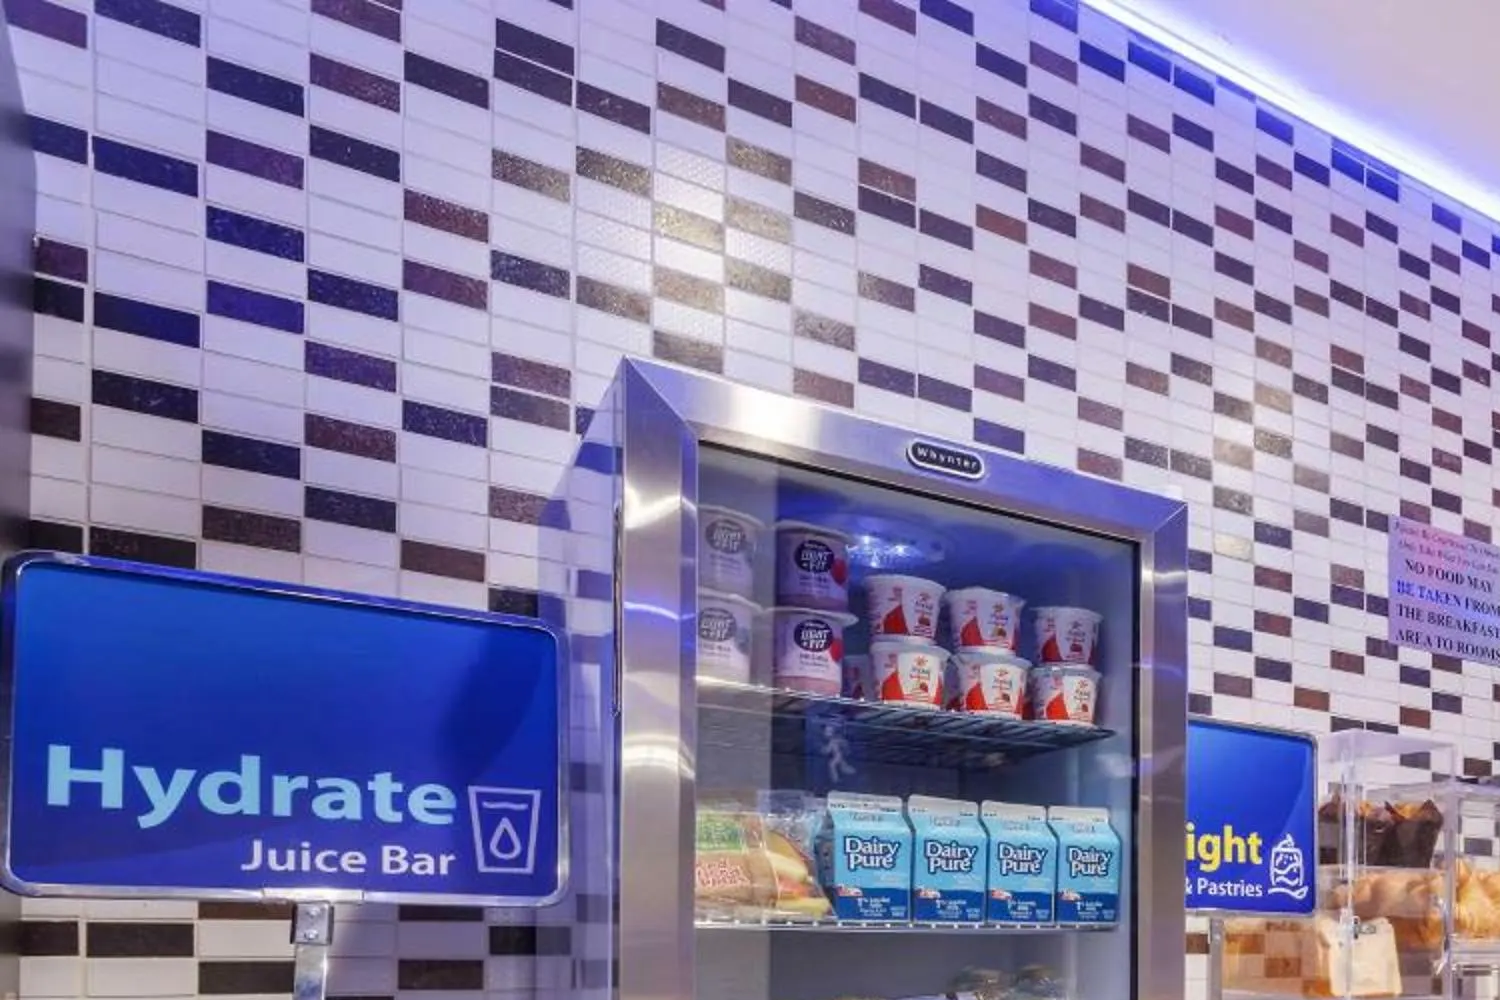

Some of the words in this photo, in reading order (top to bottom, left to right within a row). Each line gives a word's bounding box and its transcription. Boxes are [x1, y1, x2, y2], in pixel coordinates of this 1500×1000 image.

[1405, 559, 1425, 575] NO
[1428, 565, 1465, 585] FOOD
[1467, 575, 1494, 593] MAY
[1397, 580, 1416, 595] BE
[1418, 584, 1461, 607] TAKEN
[1396, 603, 1425, 622] THE
[1396, 630, 1433, 647] AREA
[1436, 637, 1453, 651] TO
[46, 743, 458, 829] Hydrate
[844, 836, 900, 856] Dairy
[925, 840, 977, 858] Dairy
[999, 843, 1047, 860] Dairy
[1068, 847, 1112, 863] Dairy
[241, 840, 367, 875] Juice
[381, 844, 456, 876] Bar
[848, 853, 894, 871] Pure
[929, 857, 972, 874] Pure
[1002, 859, 1041, 876] Pure
[1071, 861, 1108, 878] Pure
[1197, 877, 1263, 897] Pastries
